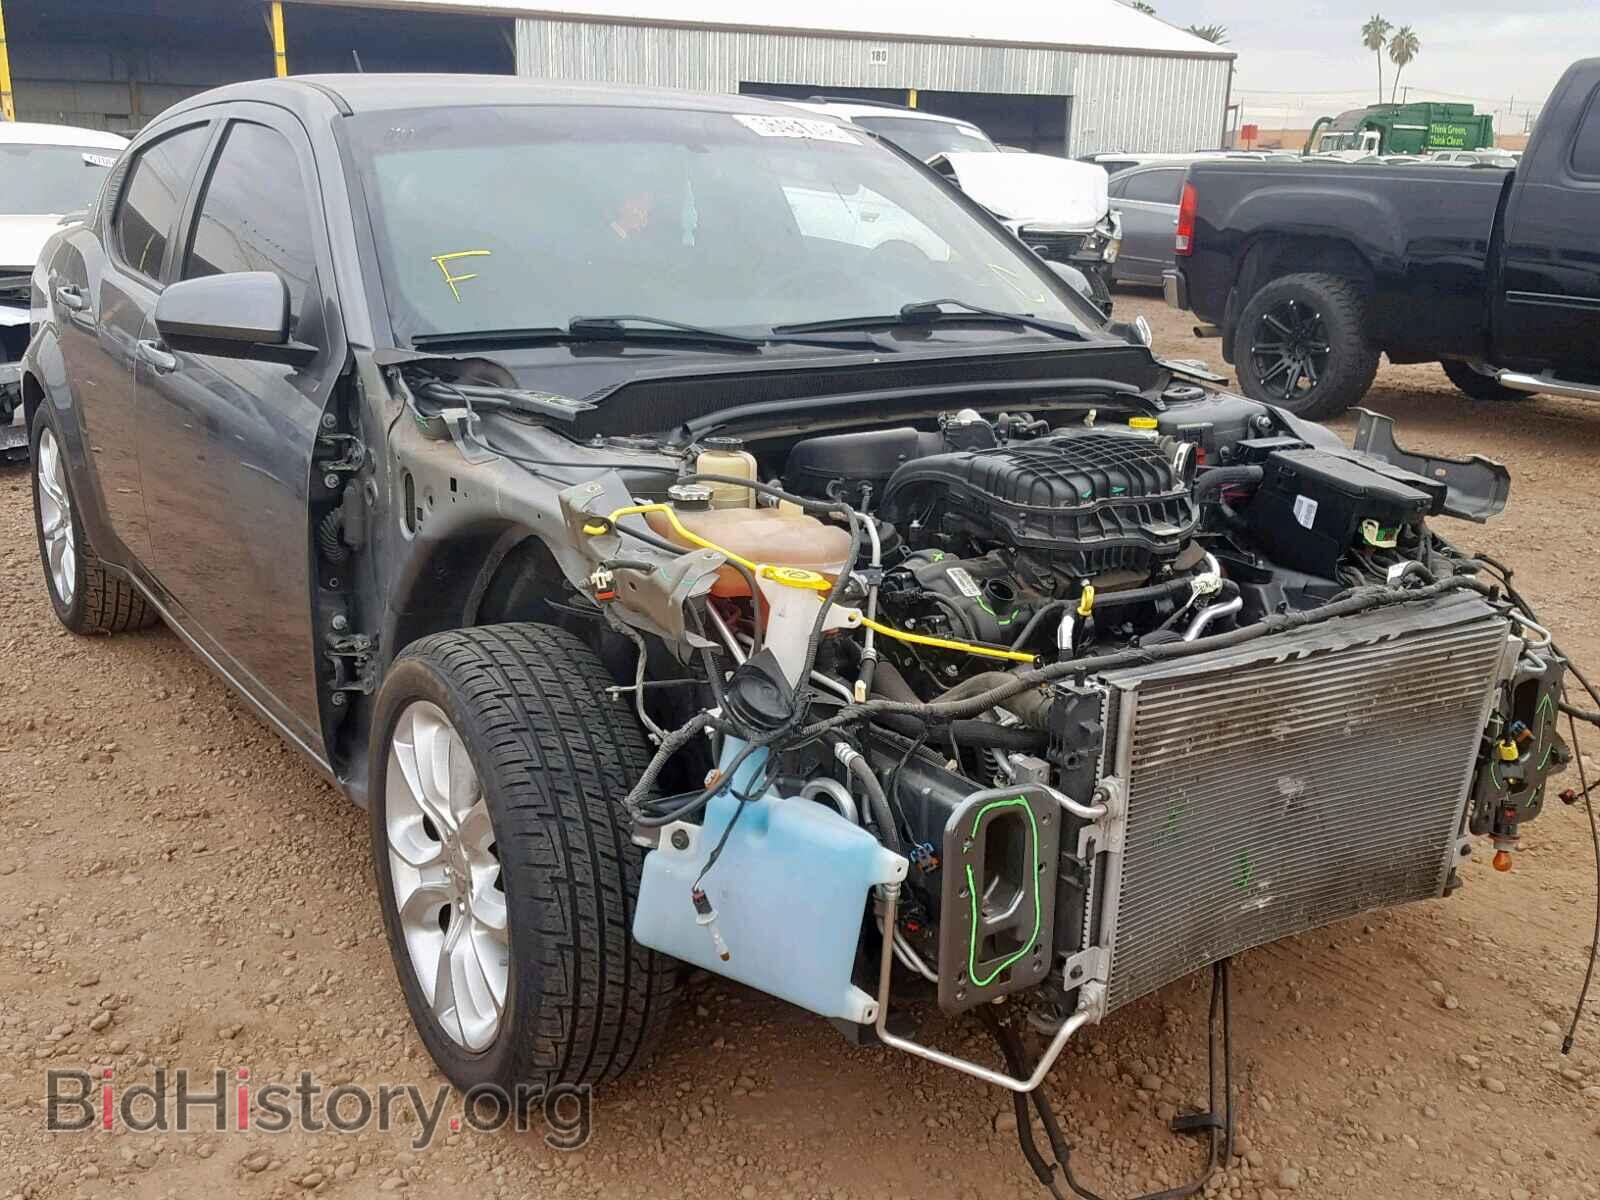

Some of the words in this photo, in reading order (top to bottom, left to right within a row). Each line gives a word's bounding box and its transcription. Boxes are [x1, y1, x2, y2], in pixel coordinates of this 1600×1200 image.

[871, 50, 887, 62] 180
[1431, 123, 1447, 134] Think
[1430, 135, 1445, 145] Think
[431, 249, 492, 304] F
